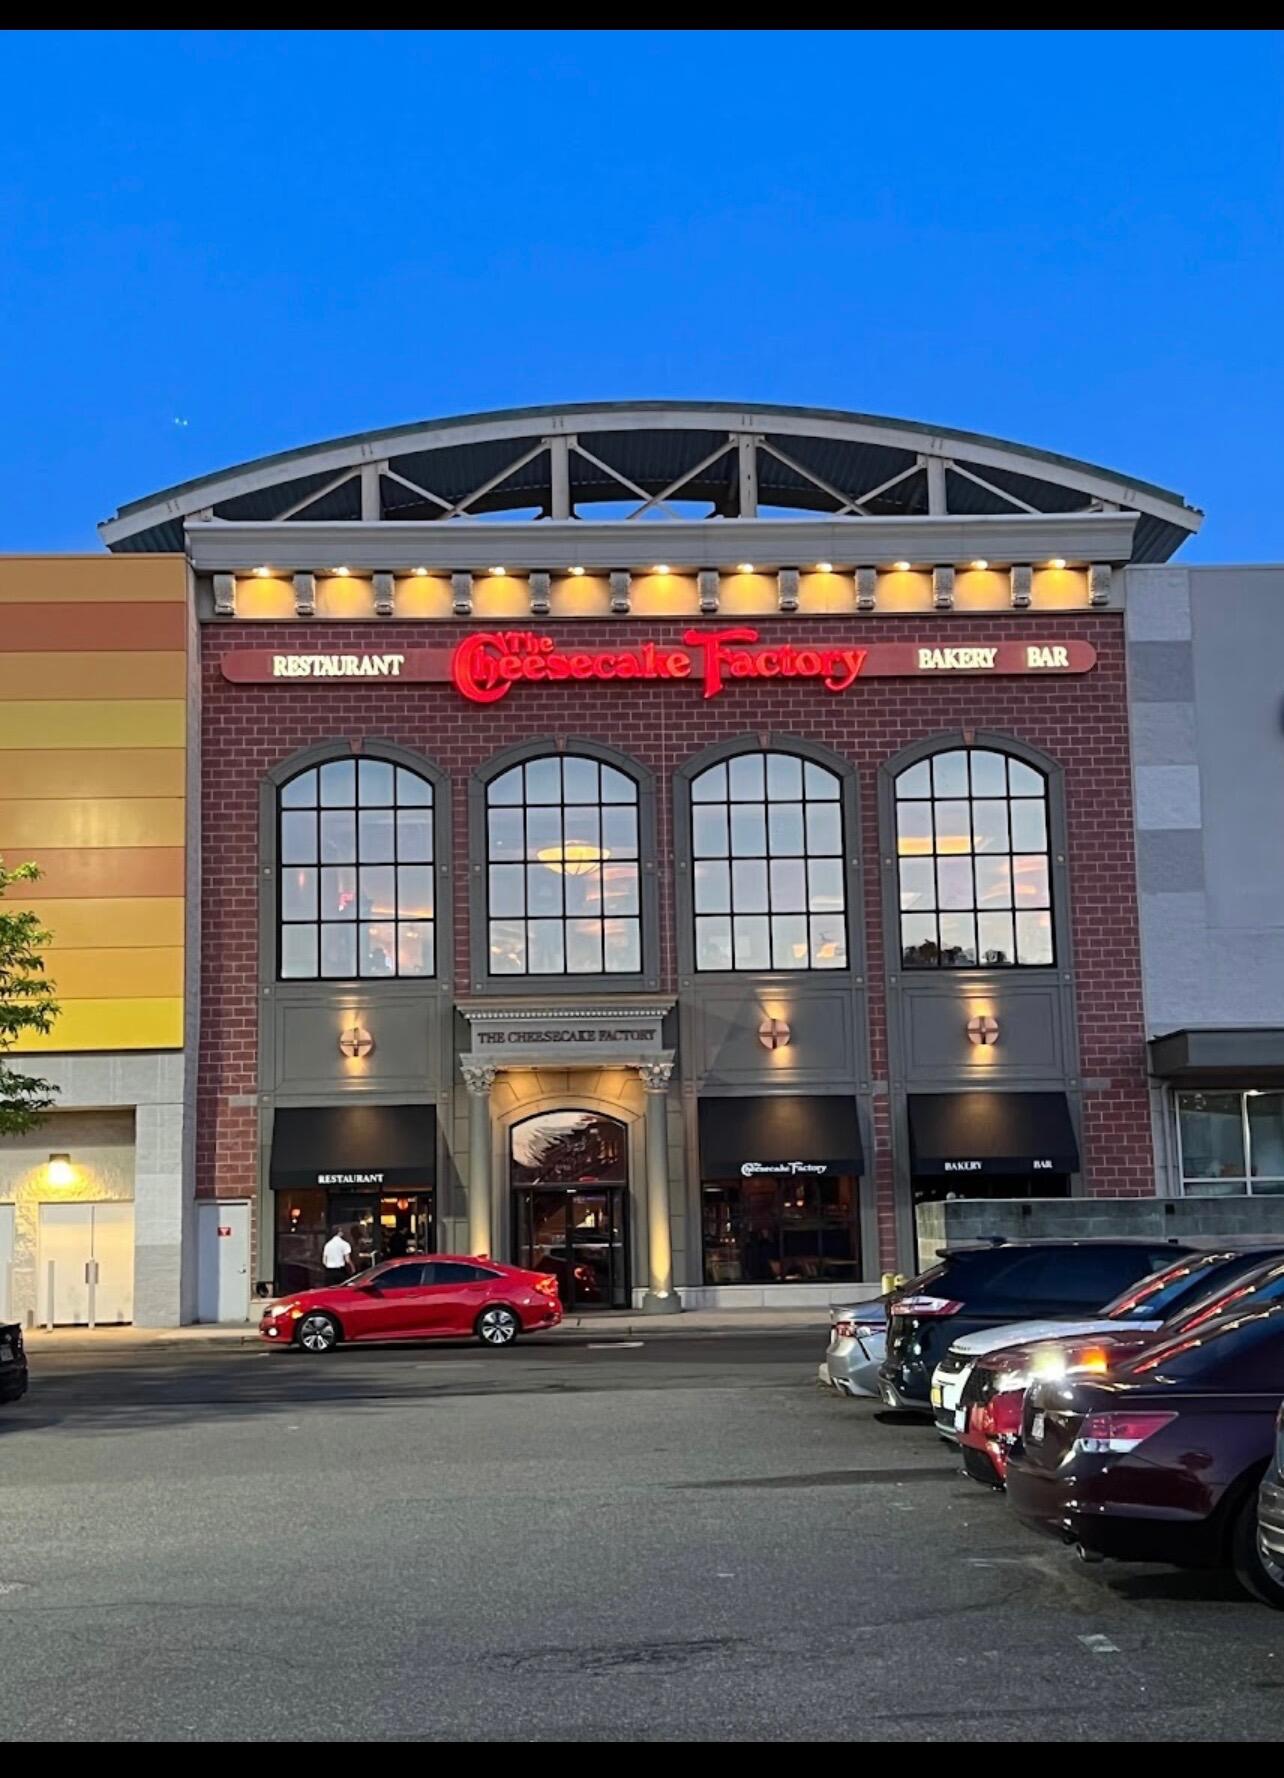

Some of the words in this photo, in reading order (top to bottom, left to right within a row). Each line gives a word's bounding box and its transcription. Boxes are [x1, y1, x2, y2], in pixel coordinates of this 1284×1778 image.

[505, 631, 554, 653] The
[272, 654, 404, 676] RESTAURANT
[454, 631, 691, 703] Cheesecake
[684, 628, 868, 699] Factory
[918, 648, 997, 669] BAKERY
[1027, 646, 1069, 668] BAR
[478, 1031, 505, 1044] THE
[508, 1030, 596, 1043] CHEESECAKE
[598, 1029, 657, 1042] FACTORY
[787, 1161, 827, 1175] Factory
[944, 1161, 983, 1171] BAKERY
[1033, 1160, 1053, 1169] BAR
[318, 1173, 384, 1185] RESTAURANT
